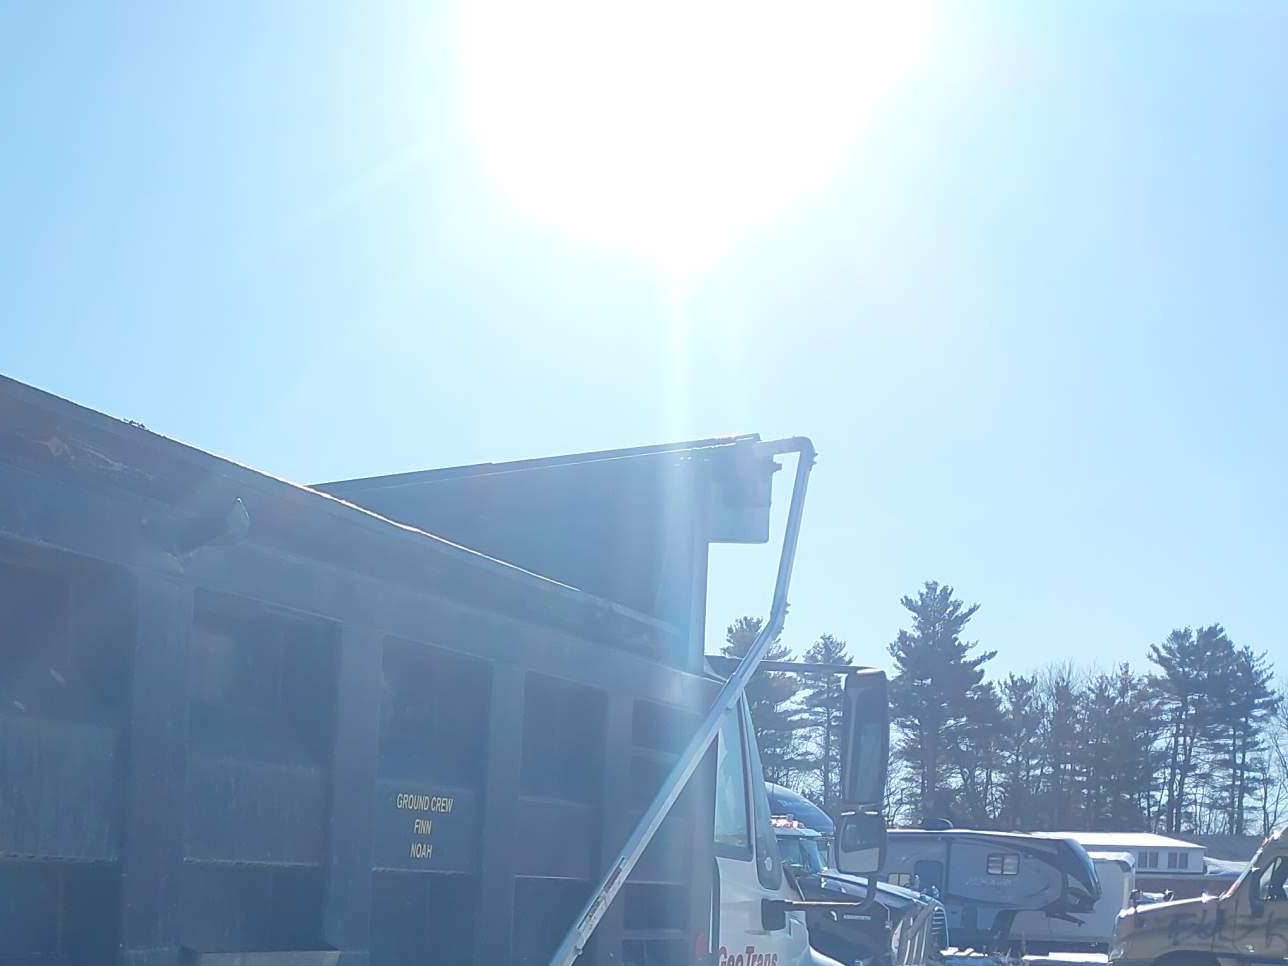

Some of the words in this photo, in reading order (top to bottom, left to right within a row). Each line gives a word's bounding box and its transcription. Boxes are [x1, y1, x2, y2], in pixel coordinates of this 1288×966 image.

[396, 793, 430, 811] GROUND
[431, 796, 454, 813] CREW
[414, 819, 432, 834] FINN
[410, 842, 432, 858] NOAH
